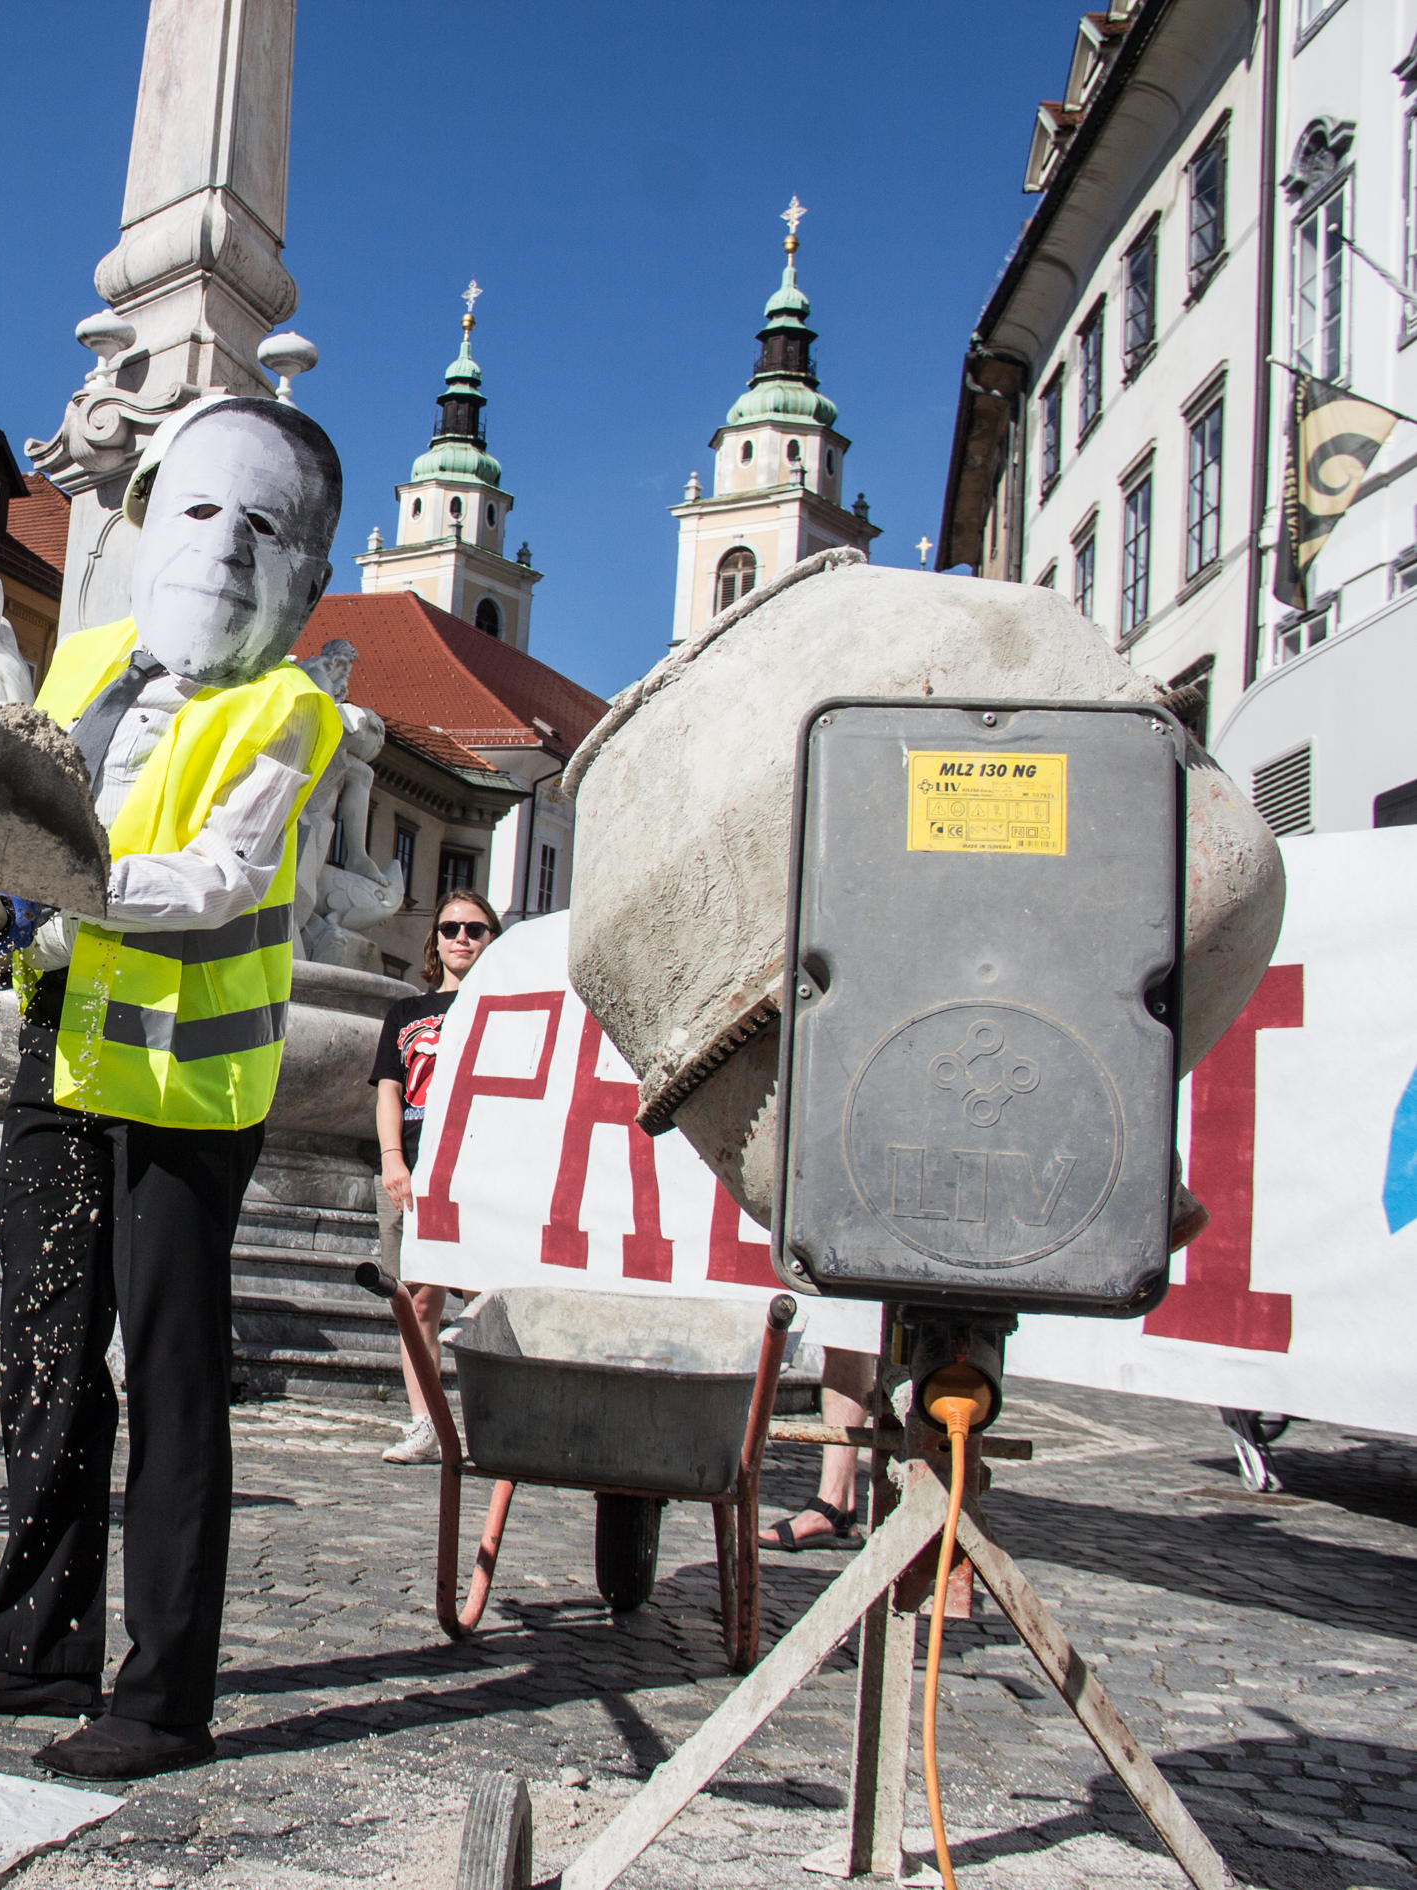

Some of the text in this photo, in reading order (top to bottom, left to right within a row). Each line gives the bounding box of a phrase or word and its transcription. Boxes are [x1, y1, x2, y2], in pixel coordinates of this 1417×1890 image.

[939, 763, 1037, 778] MLZ 130 NG
[935, 782, 961, 792] LIV
[888, 1145, 1078, 1227] LIV
